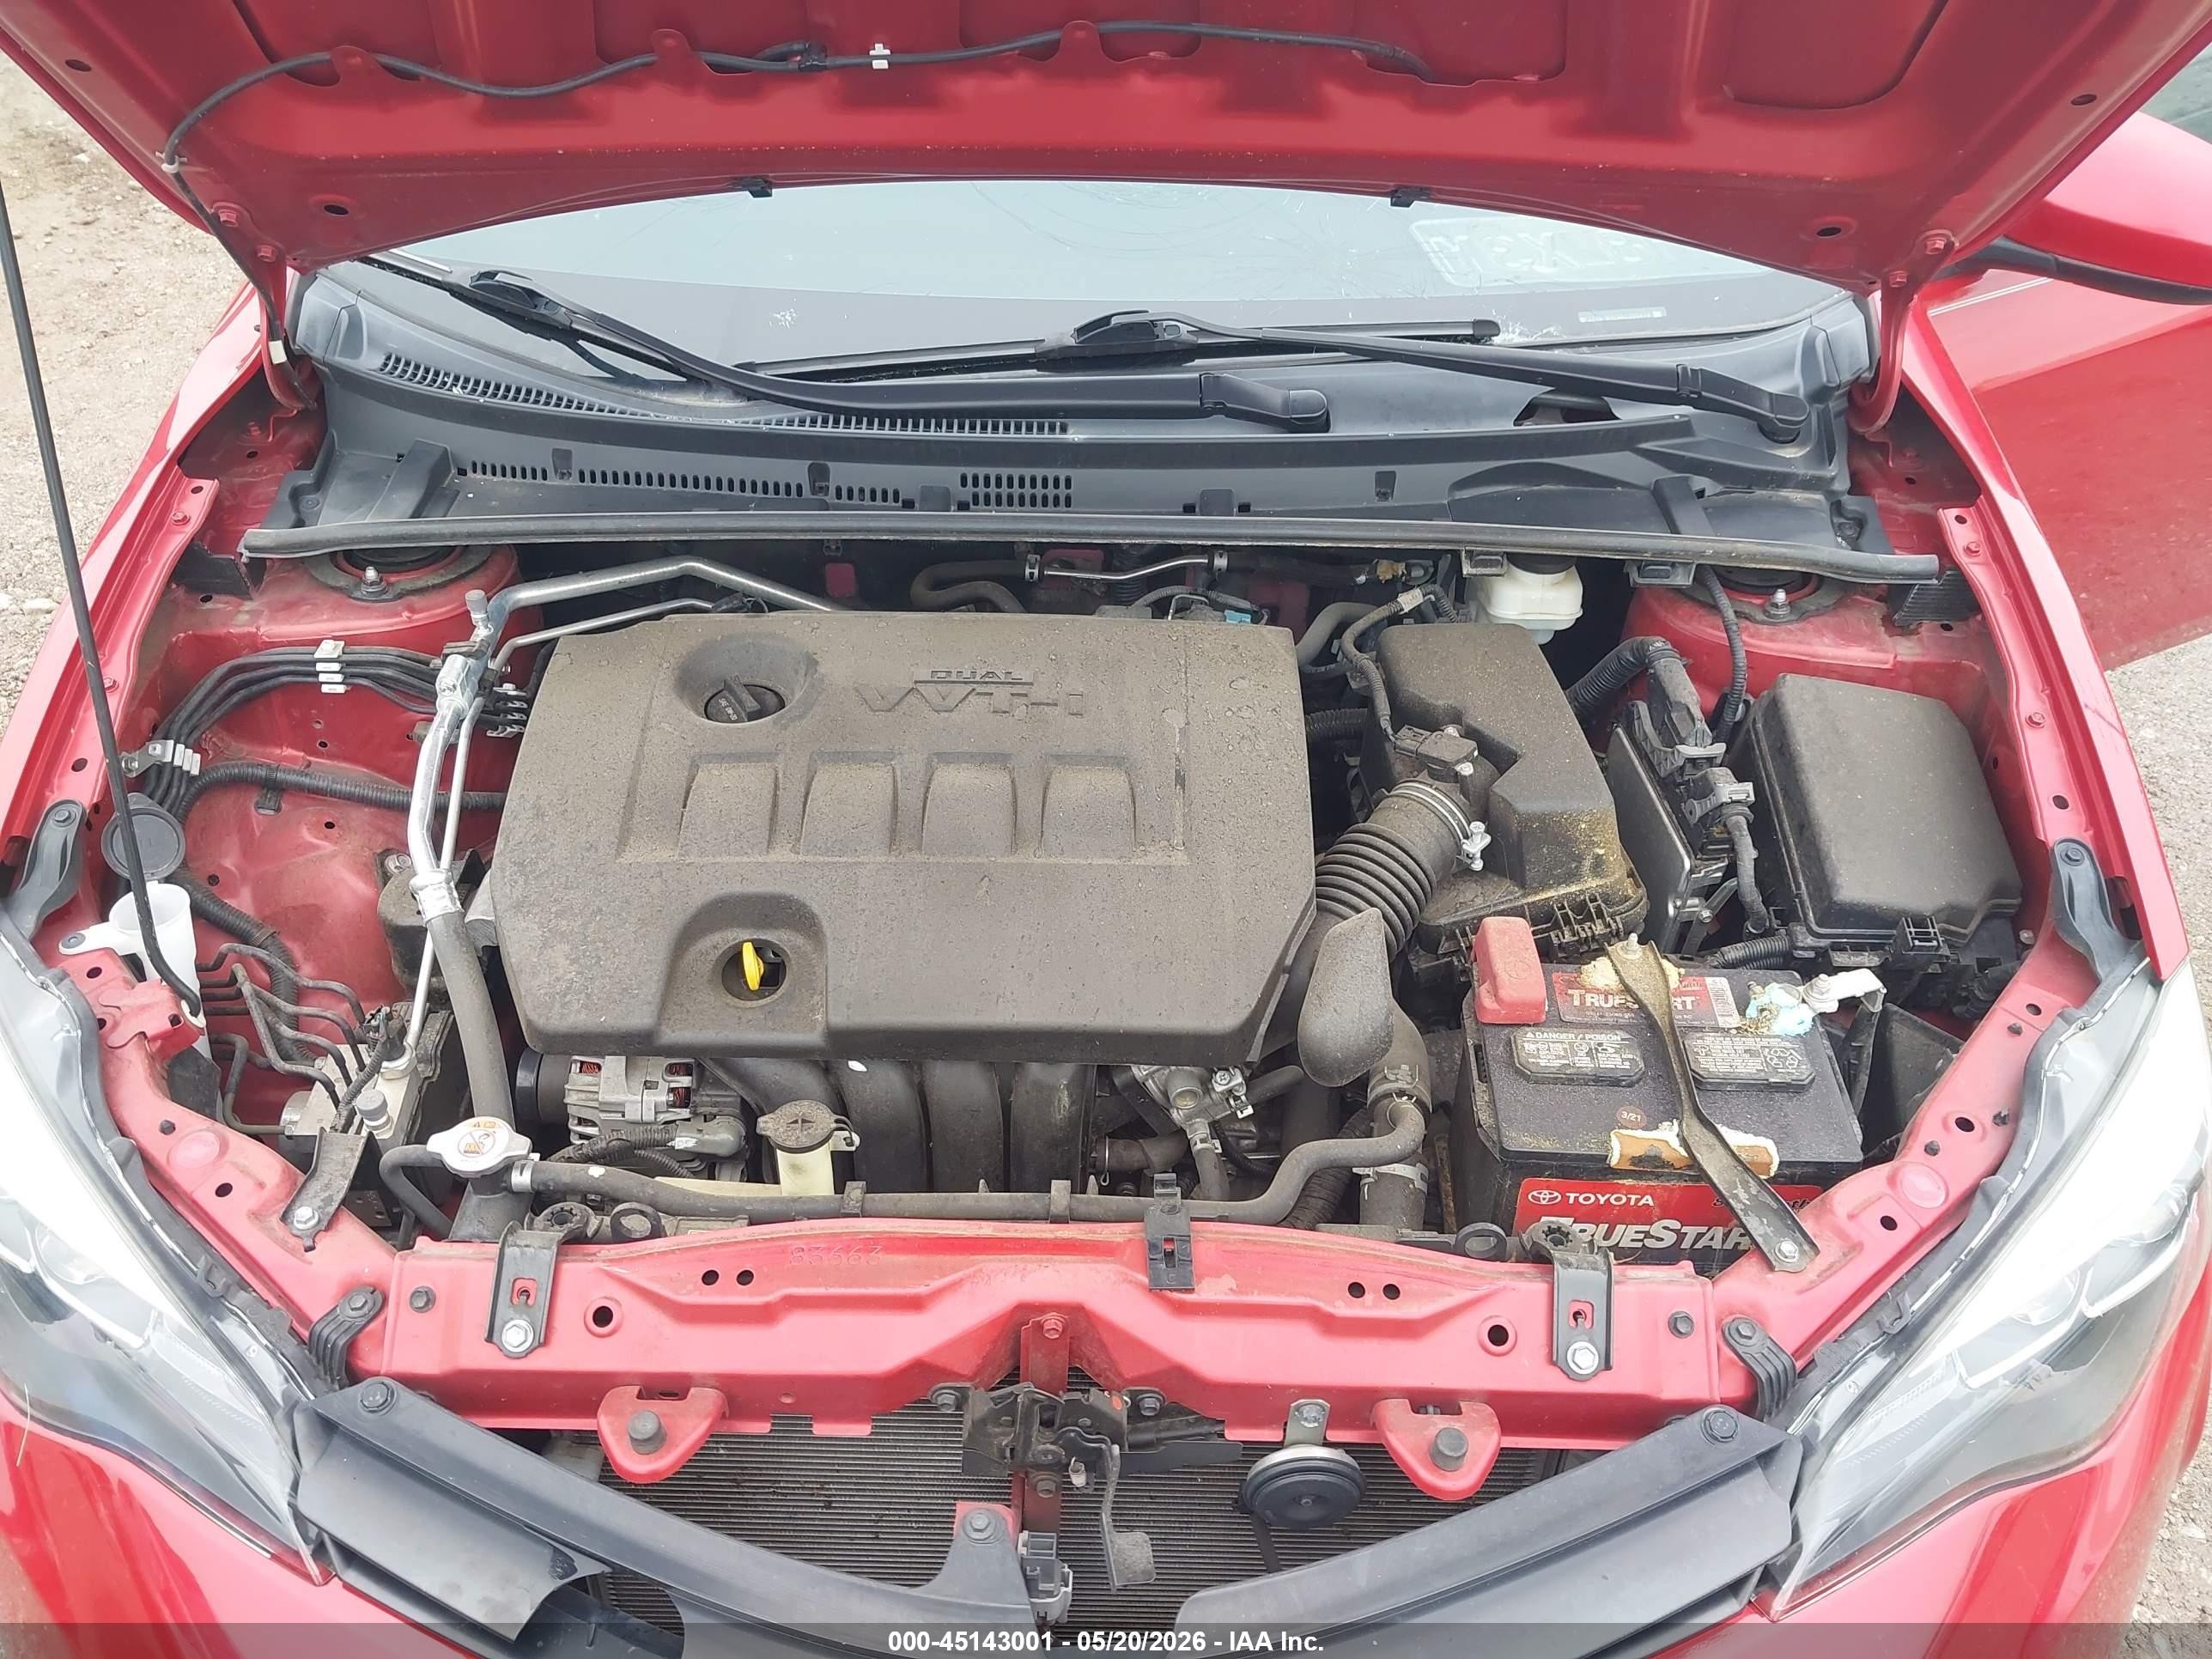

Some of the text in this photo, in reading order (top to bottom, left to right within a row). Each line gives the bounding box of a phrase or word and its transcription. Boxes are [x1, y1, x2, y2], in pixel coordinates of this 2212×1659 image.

[930, 670, 1024, 681] DUAL
[1620, 1111, 1642, 1121] 3/21
[1565, 1192, 1655, 1206] TOYOTA
